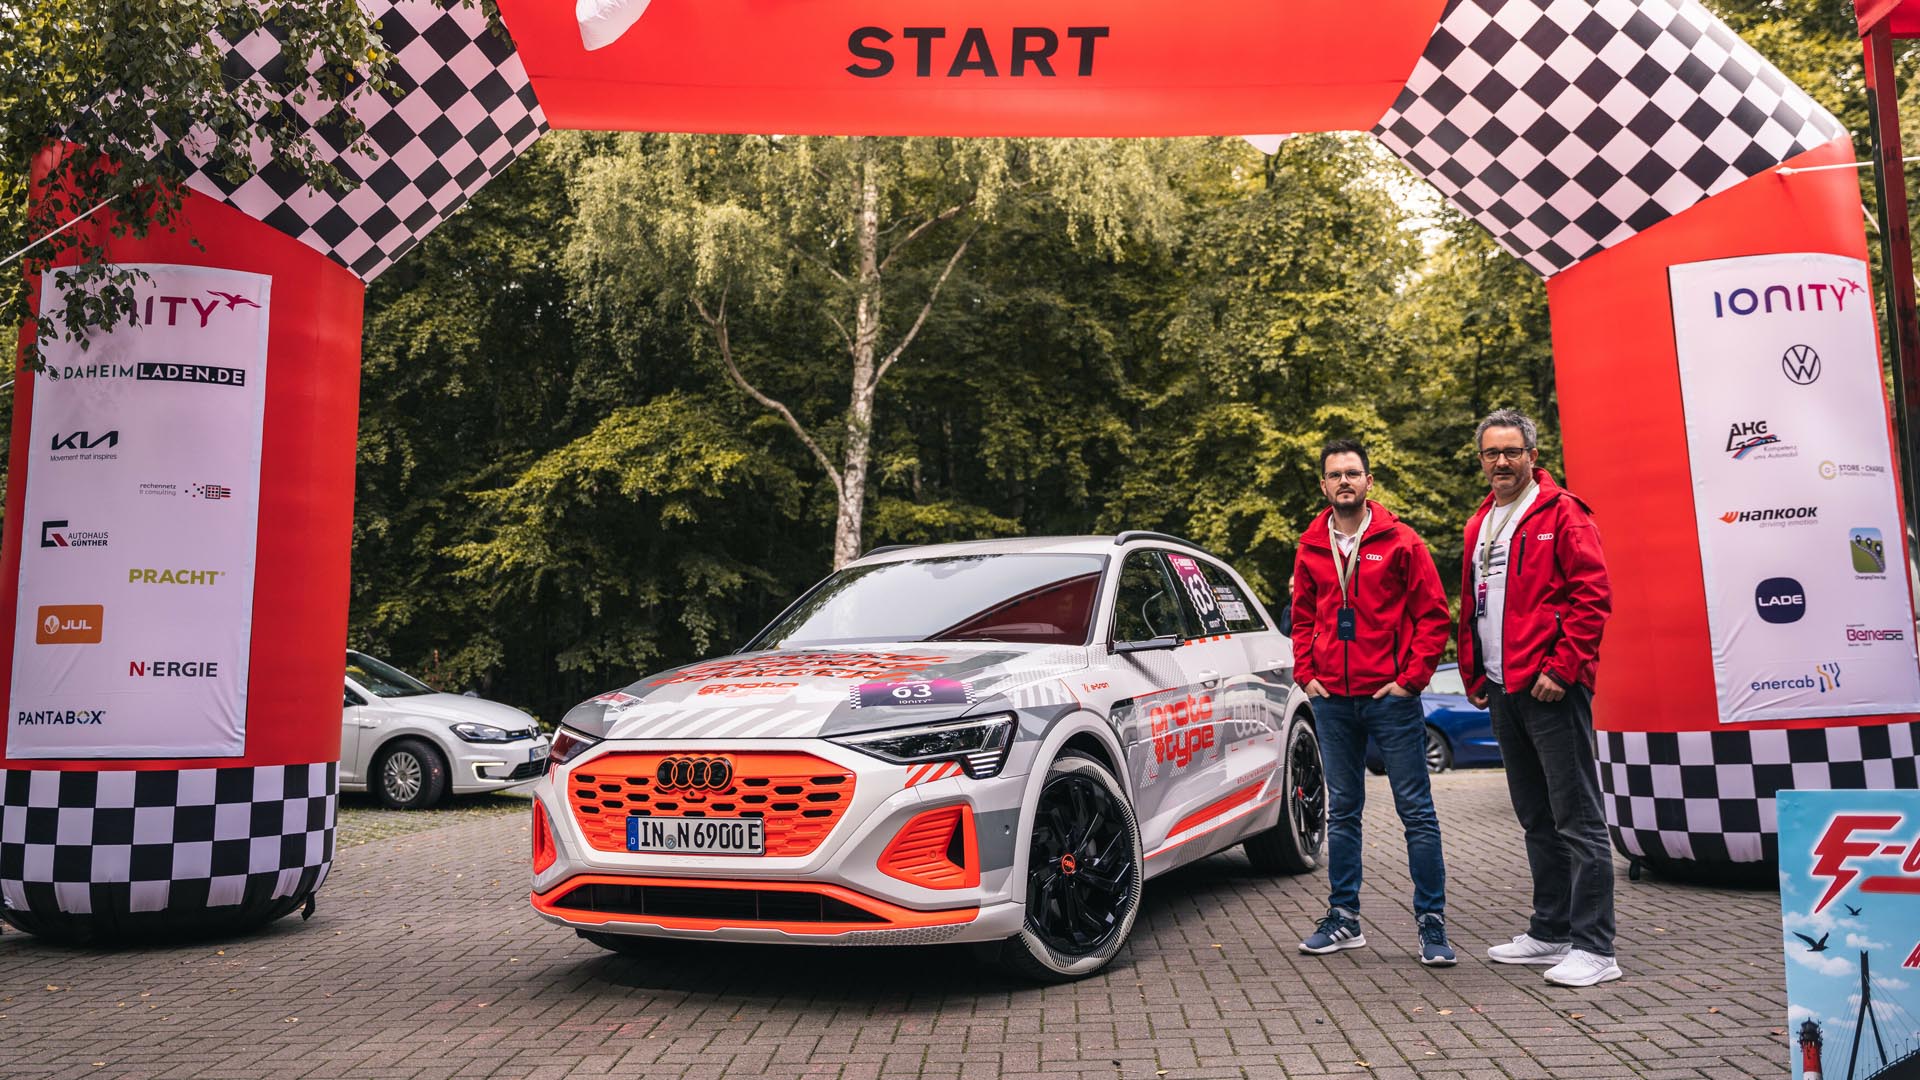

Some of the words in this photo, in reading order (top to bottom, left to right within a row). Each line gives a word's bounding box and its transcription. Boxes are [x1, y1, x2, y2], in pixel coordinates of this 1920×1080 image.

[845, 26, 1110, 78] START
[1714, 284, 1846, 318] IONITY
[68, 531, 109, 539] AUTOHAUS
[71, 538, 108, 547] GÜNTHER
[128, 568, 219, 585] PRACHT
[1188, 574, 1215, 615] 63
[1758, 595, 1804, 607] LADE
[61, 619, 92, 630] JUL
[892, 684, 932, 698] 63
[1752, 675, 1815, 691] enercab
[1150, 693, 1214, 741] proto
[641, 821, 664, 847] IN
